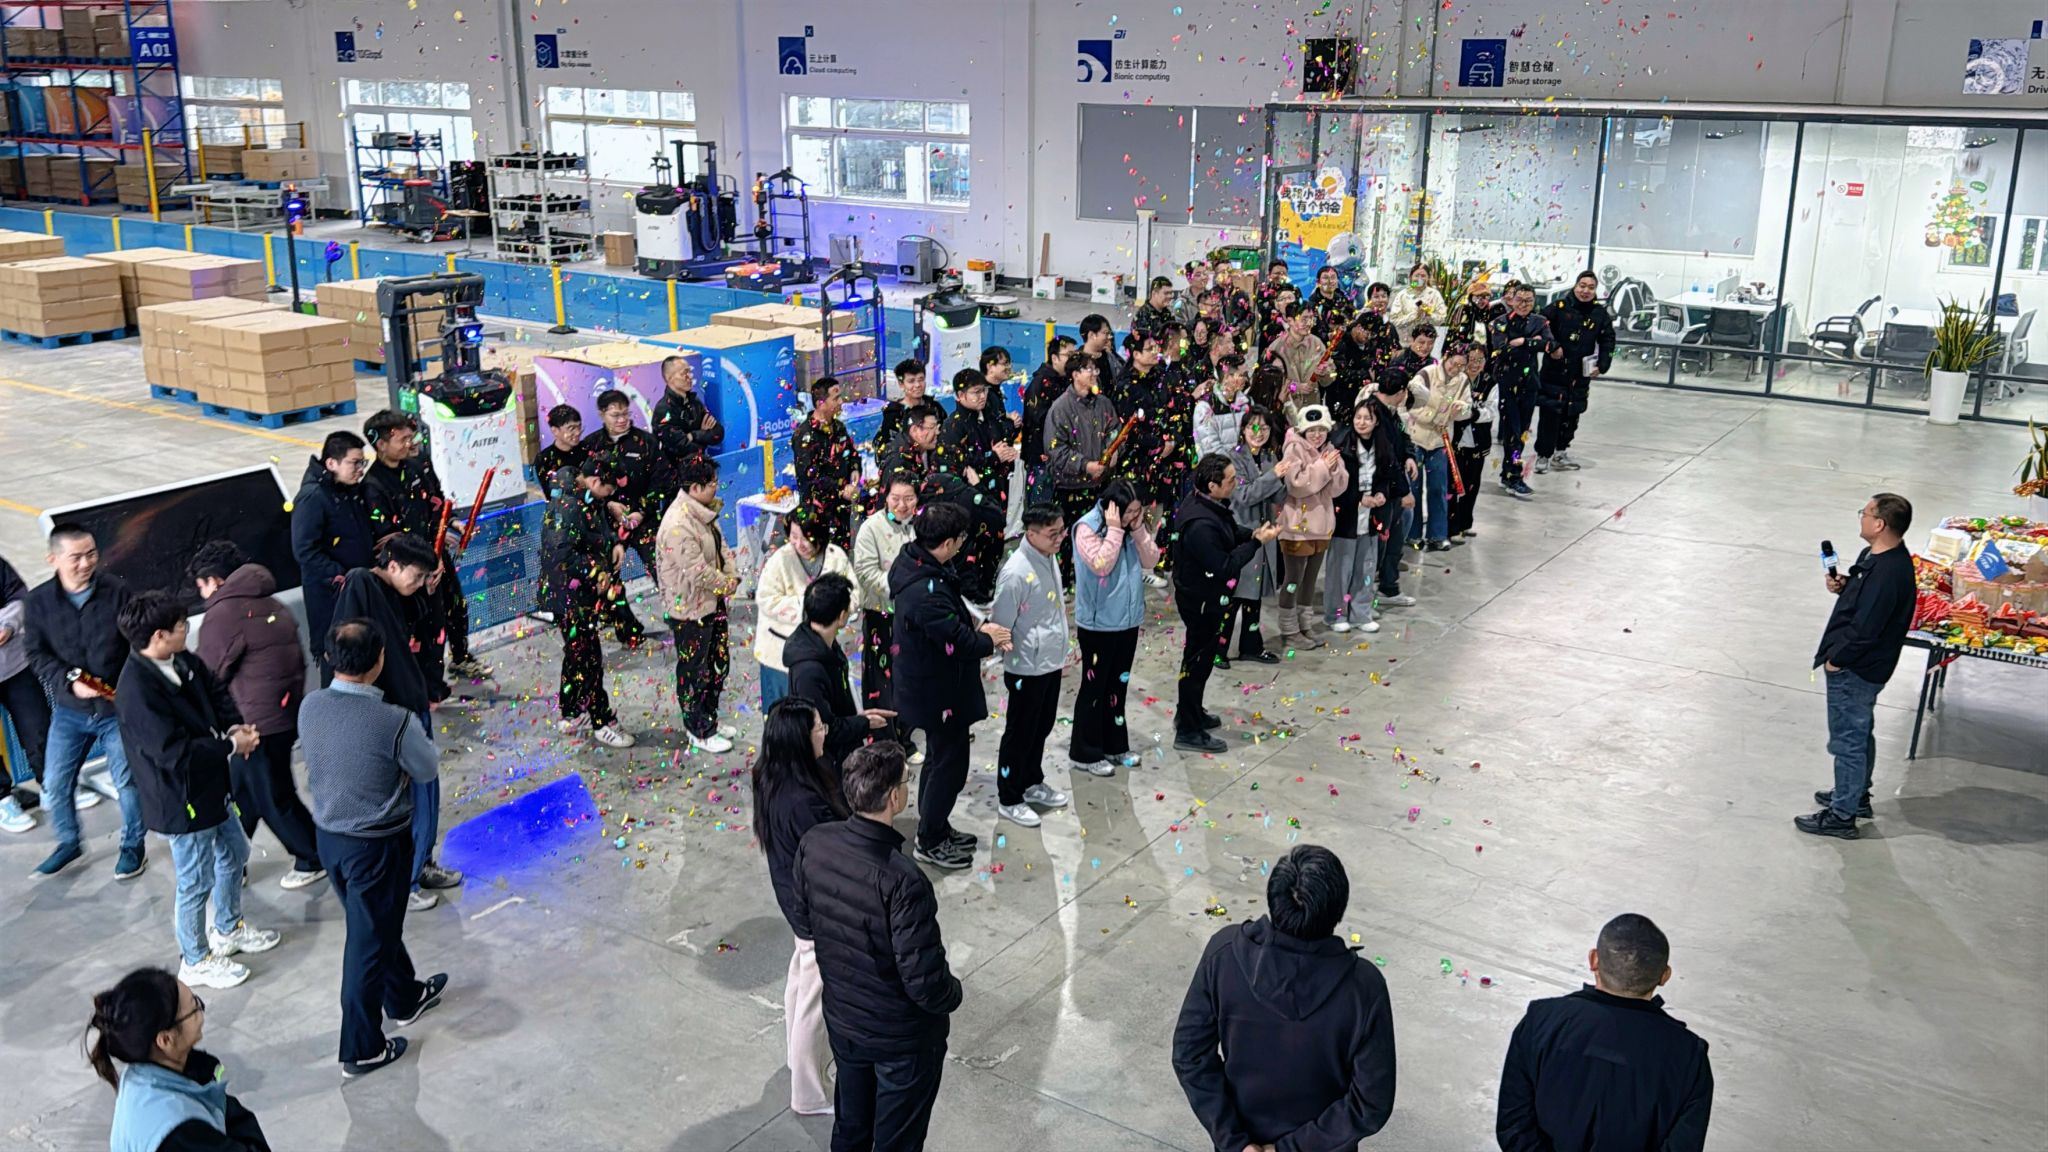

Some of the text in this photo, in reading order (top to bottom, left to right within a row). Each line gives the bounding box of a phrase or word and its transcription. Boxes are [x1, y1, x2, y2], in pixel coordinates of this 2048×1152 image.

[140, 43, 172, 57] A01
[809, 54, 837, 63] 云上计算
[1115, 59, 1167, 70] 仿生计算能力
[1509, 61, 1554, 73] 智慧仓储
[827, 68, 857, 76] computing
[1114, 72, 1170, 82] Bionic computing
[2031, 66, 2048, 80] 无
[1507, 77, 1562, 87] Smart storage
